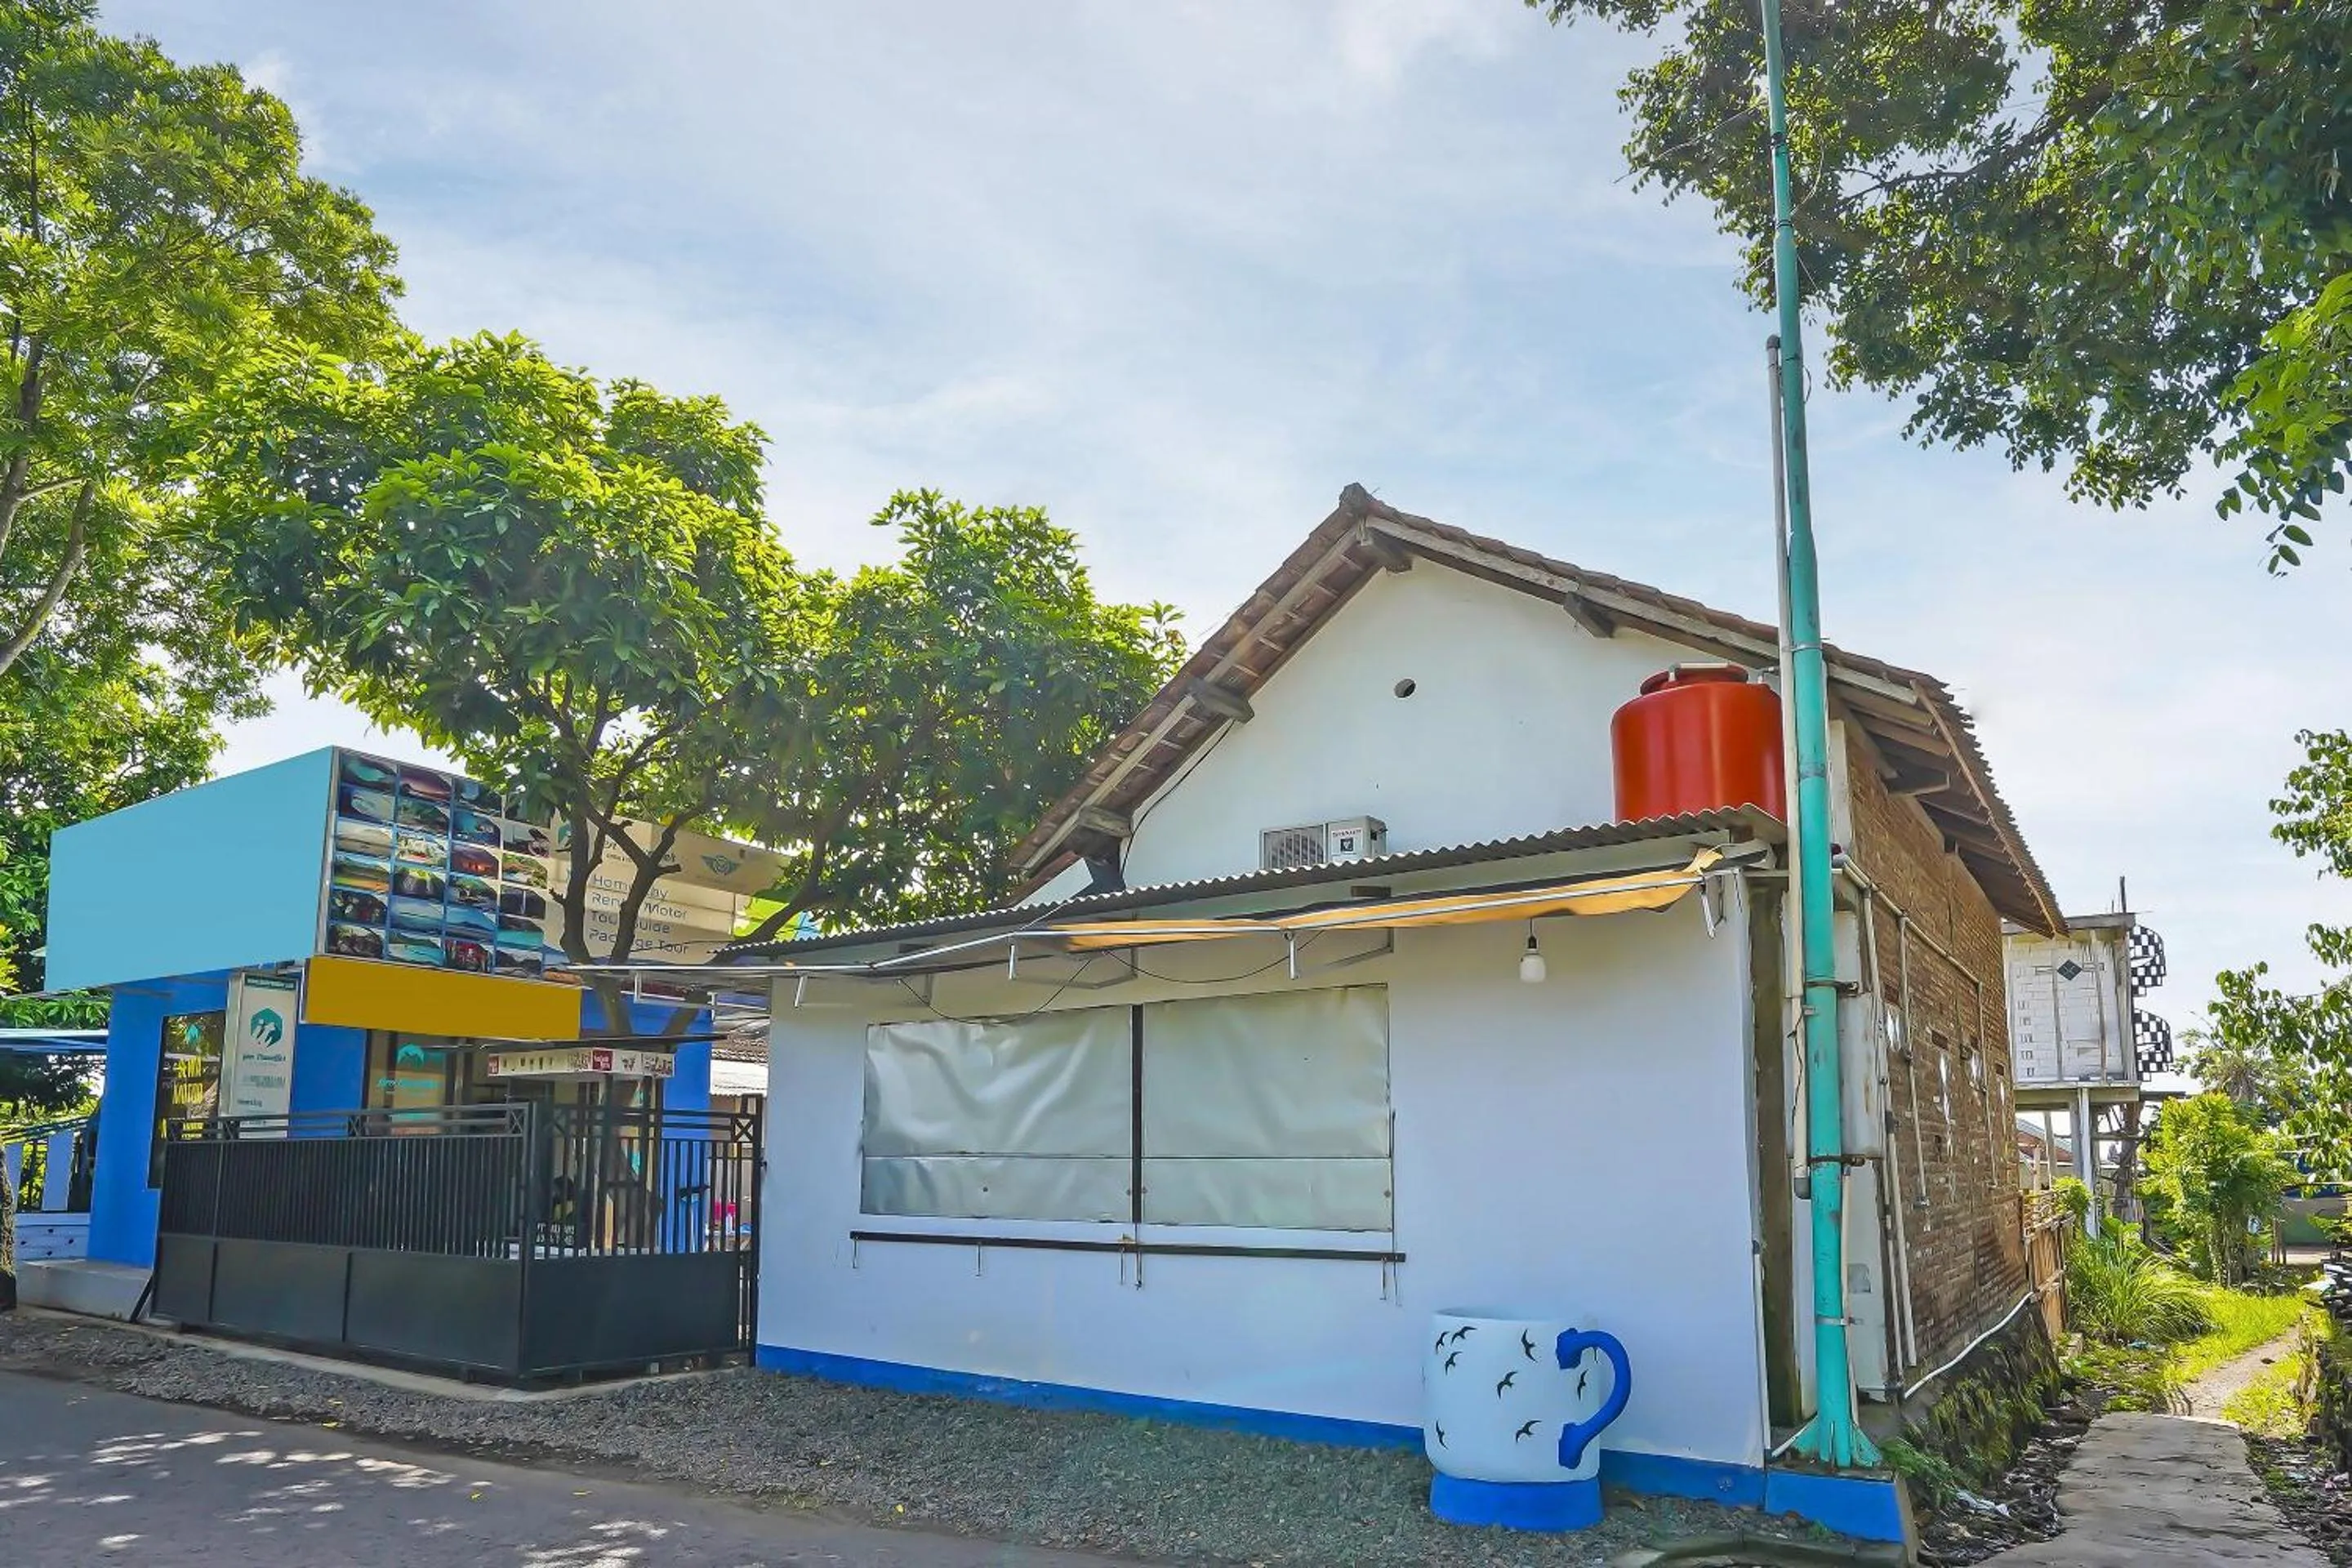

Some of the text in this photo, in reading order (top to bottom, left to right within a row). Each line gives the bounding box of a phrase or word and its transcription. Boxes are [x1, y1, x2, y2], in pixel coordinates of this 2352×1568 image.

[593, 874, 668, 899] Homay
[591, 911, 670, 934] Tou uide
[644, 902, 687, 920] Motor
[588, 928, 653, 951] Pacge
